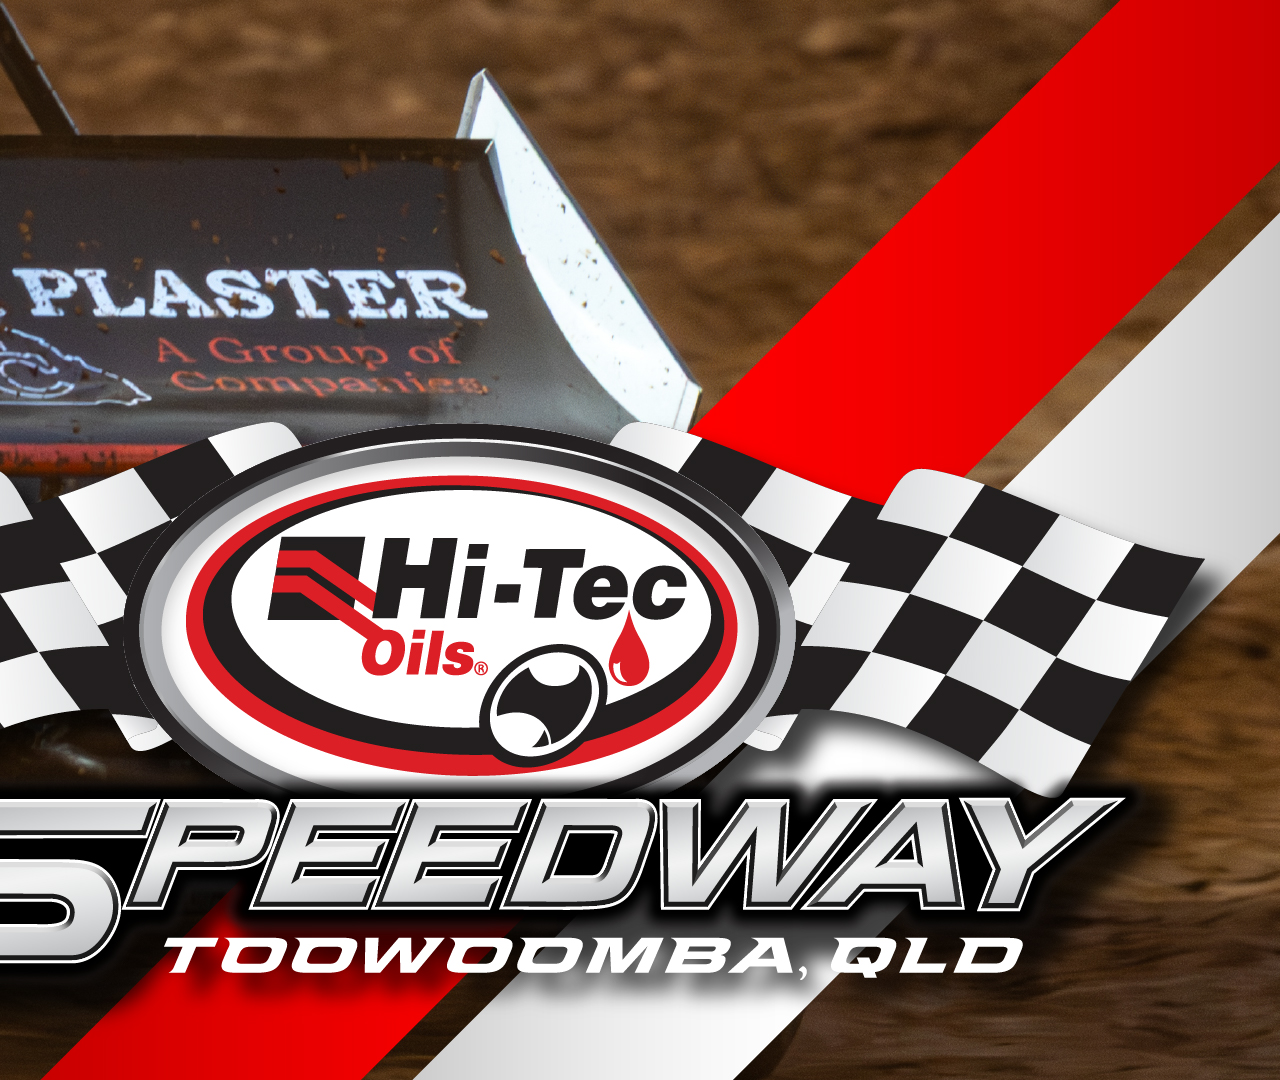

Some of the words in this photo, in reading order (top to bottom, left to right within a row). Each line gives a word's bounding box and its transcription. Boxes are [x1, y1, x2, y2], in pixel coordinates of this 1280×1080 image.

[12, 267, 489, 319] PLASTER
[157, 336, 197, 364] A
[208, 335, 388, 372] Group
[408, 336, 462, 364] of
[170, 370, 488, 398] Companies
